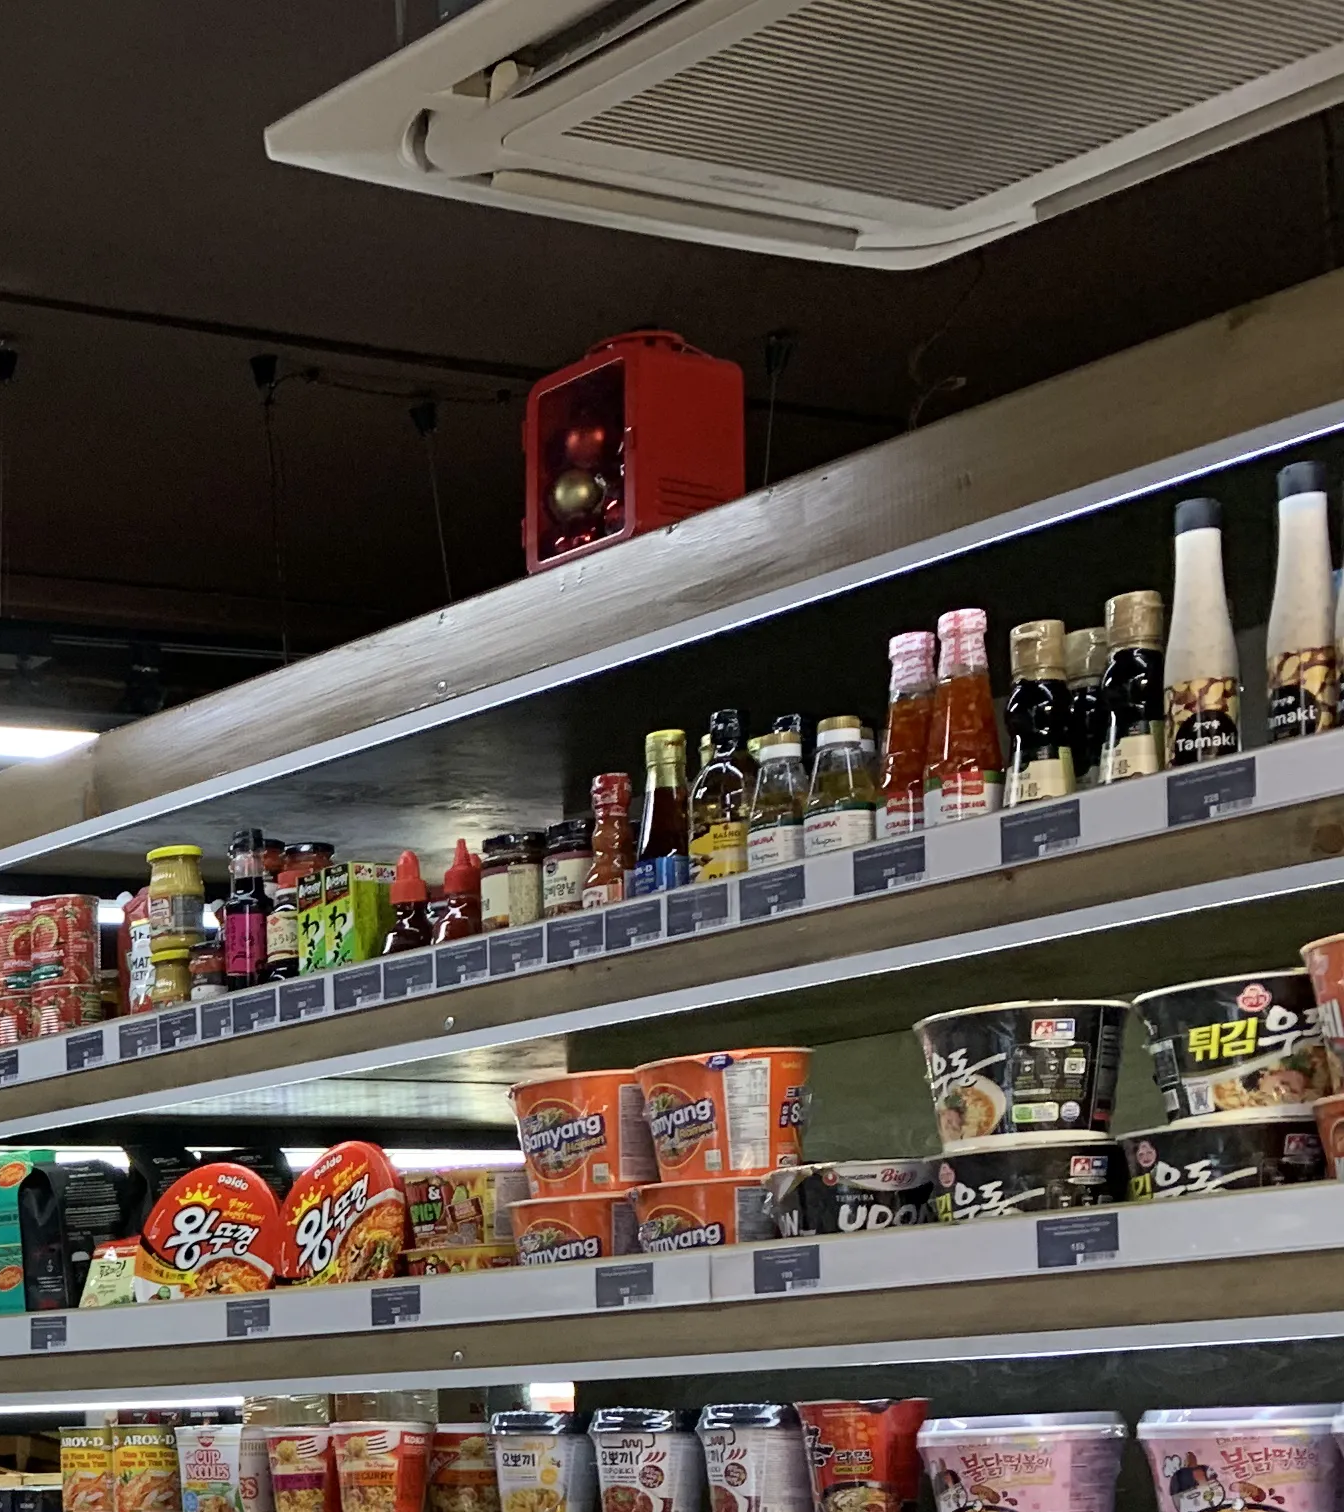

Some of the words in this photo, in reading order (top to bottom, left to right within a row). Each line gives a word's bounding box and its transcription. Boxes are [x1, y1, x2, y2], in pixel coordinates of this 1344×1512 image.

[1175, 732, 1236, 752] Tamaki
[1187, 1015, 1257, 1061] 튀김
[523, 1114, 602, 1153] Samyang
[313, 1153, 344, 1180] paldo
[217, 1173, 249, 1192] paldo
[124, 1434, 174, 1445] AROY-D
[195, 1450, 220, 1465] CUP
[502, 1453, 536, 1467] 요뽀끼
[601, 1451, 634, 1466] 요뽀끼
[959, 1449, 1053, 1479] 불닭떡볶이
[186, 1464, 230, 1480] NOODLES
[362, 1472, 394, 1480] CURRY
